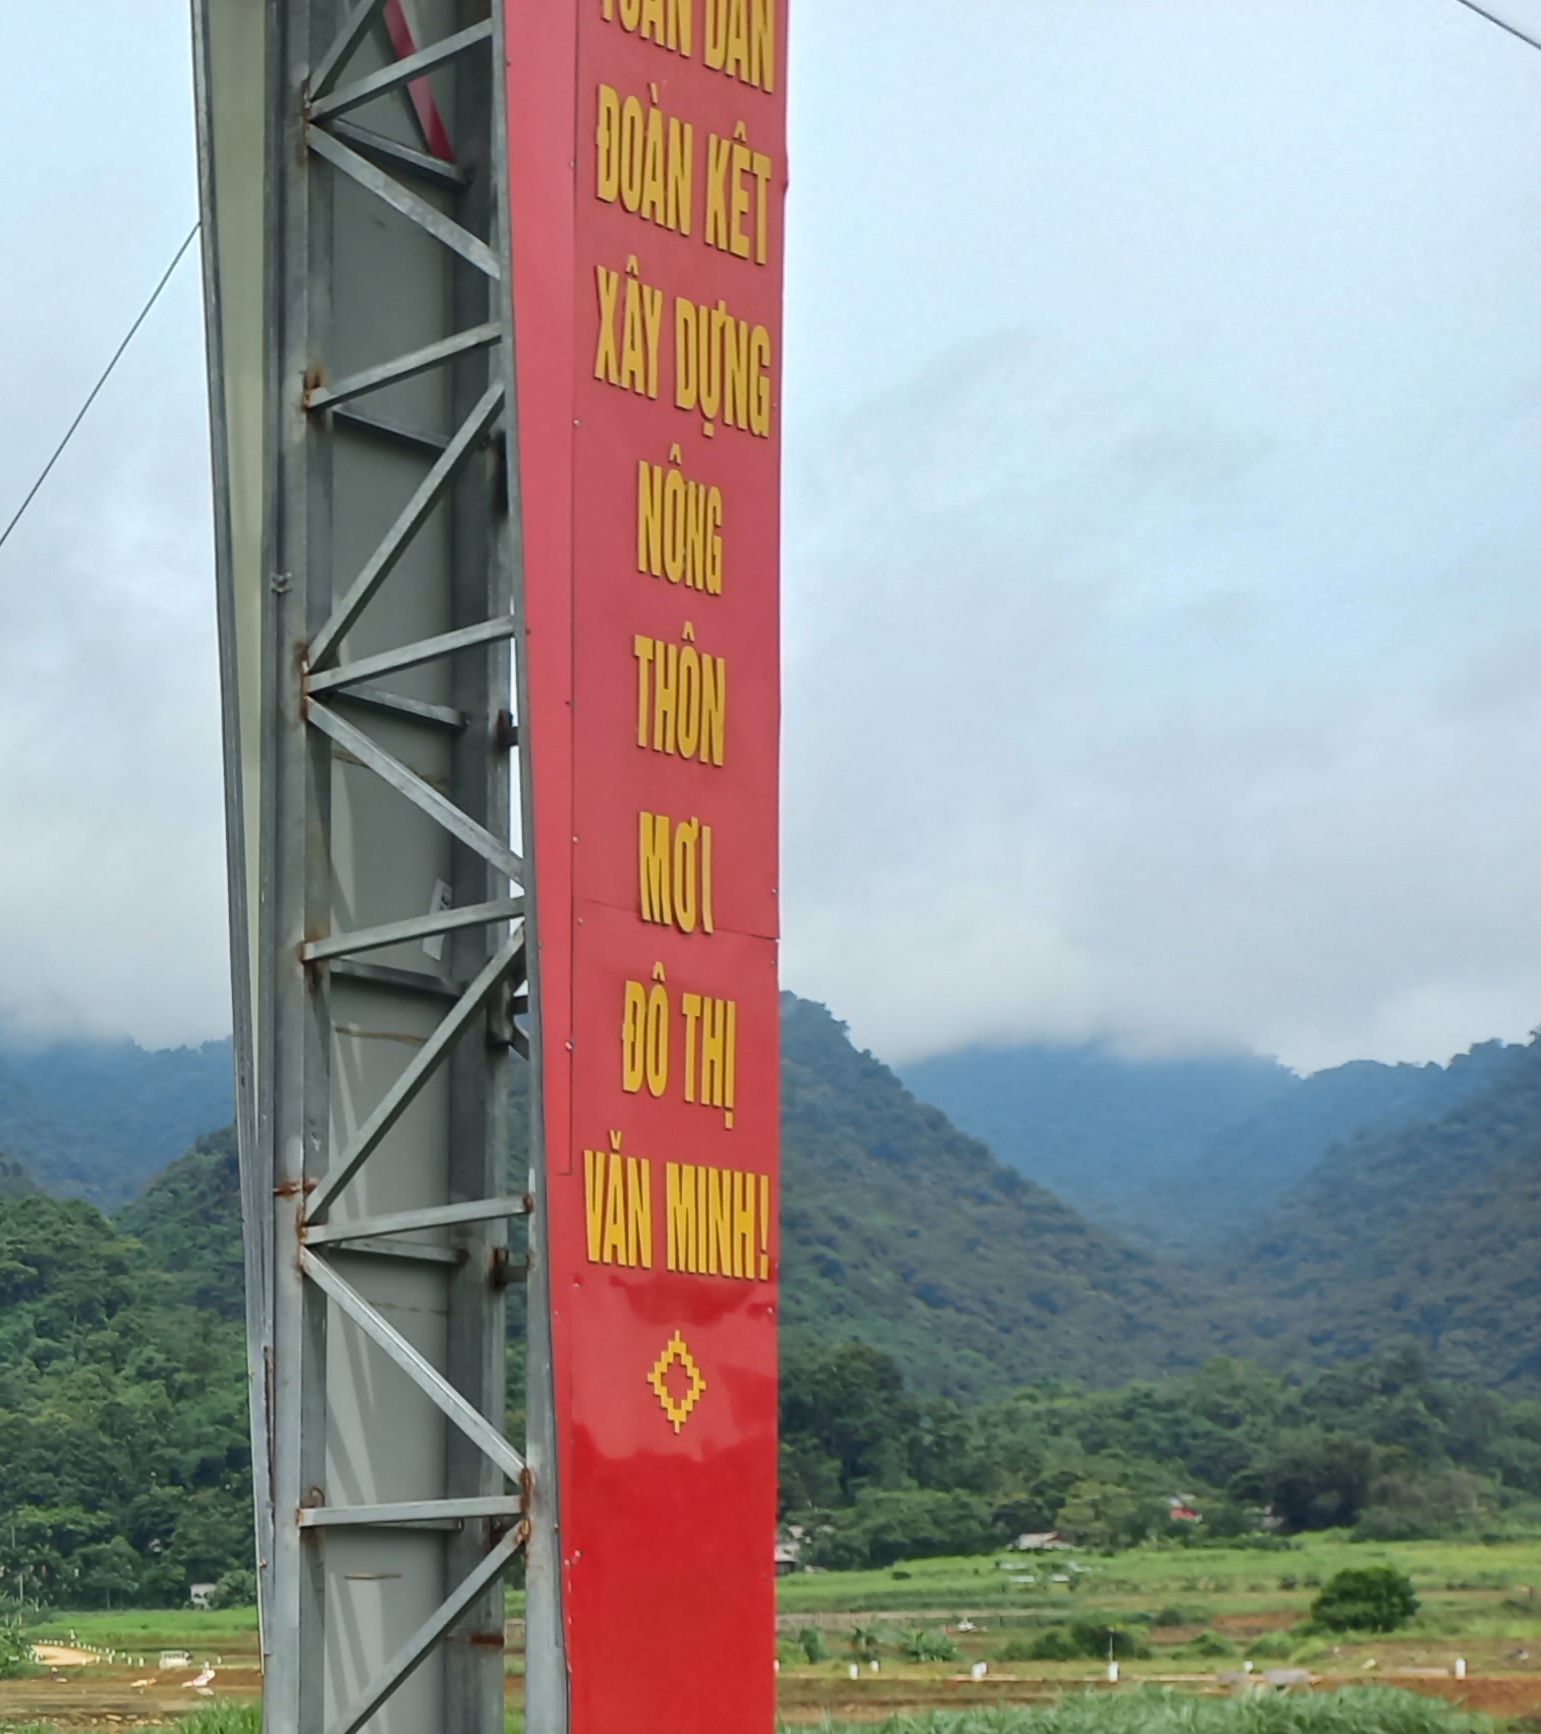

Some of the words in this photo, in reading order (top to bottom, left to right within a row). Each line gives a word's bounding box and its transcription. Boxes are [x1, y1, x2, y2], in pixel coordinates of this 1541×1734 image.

[597, 83, 692, 236] ĐOÀN
[595, 255, 663, 399] XÂY
[675, 297, 770, 438] DỰNG
[637, 443, 722, 596] NÔNG
[633, 620, 725, 767] THÔN
[621, 961, 669, 1097] ĐÔ
[682, 992, 736, 1130] THỊ
[583, 1129, 652, 1269] VĂN
[665, 1161, 770, 1281] MINH!
